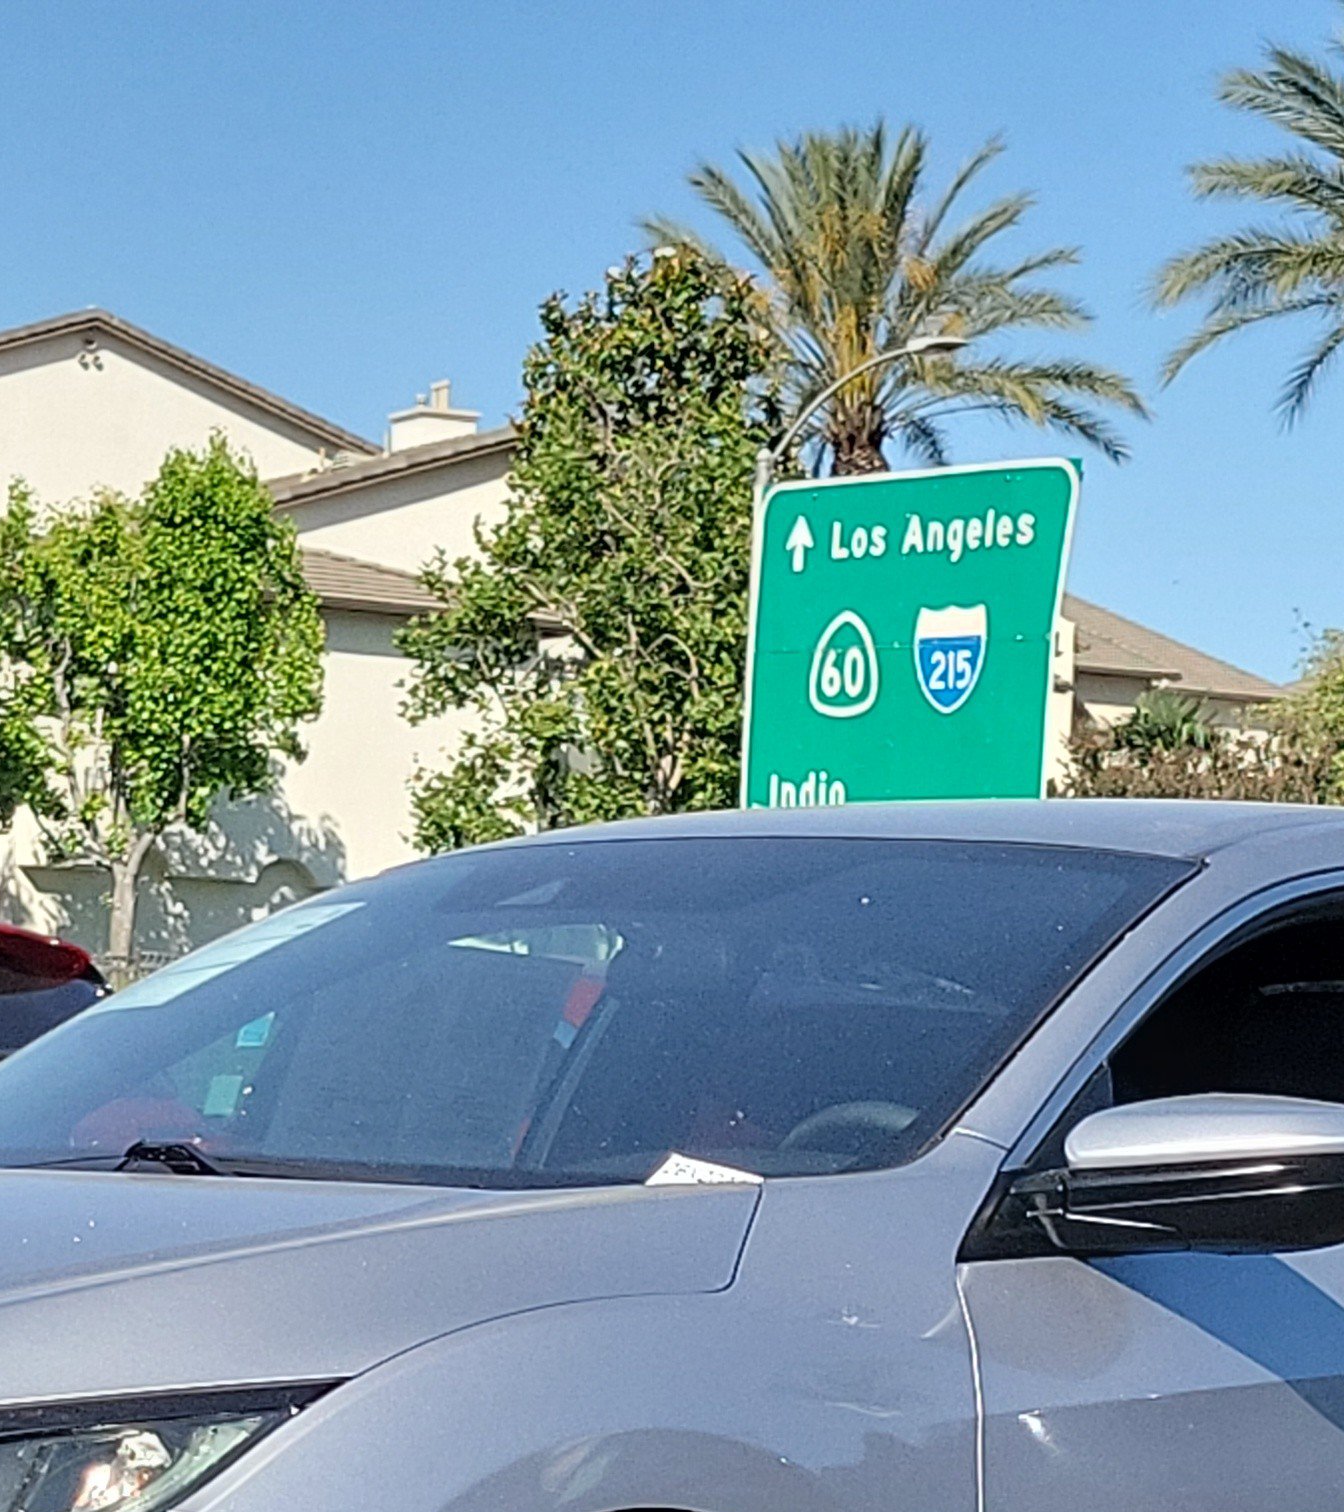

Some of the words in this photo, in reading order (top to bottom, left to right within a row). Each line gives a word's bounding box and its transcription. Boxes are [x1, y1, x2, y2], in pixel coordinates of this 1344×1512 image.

[830, 520, 888, 560] Los
[901, 507, 1036, 563] Angeles
[820, 645, 865, 698] 60
[928, 650, 972, 691] 215
[768, 770, 846, 806] Indio
